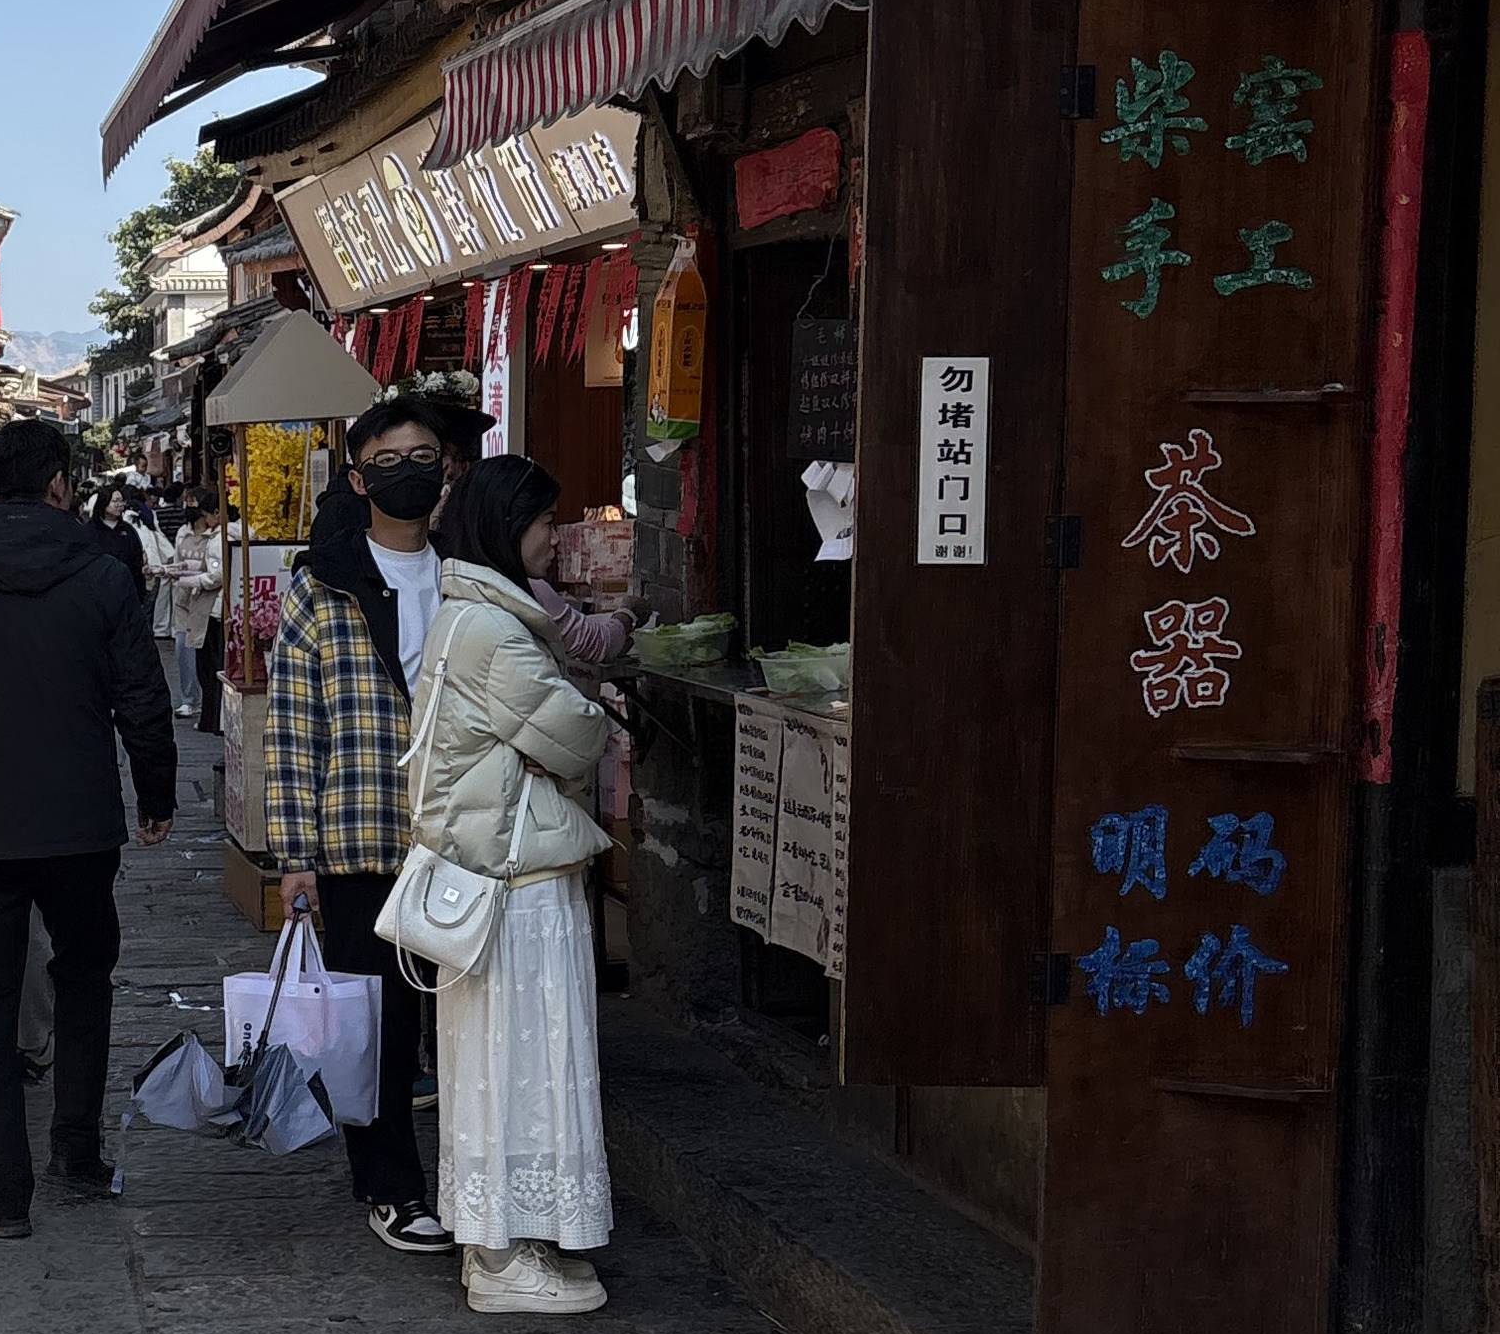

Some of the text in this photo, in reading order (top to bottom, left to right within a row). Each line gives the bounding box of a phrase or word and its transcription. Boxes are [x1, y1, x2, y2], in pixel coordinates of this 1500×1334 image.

[546, 131, 632, 214] 旗舰店
[1100, 197, 1316, 319] 手工
[936, 364, 976, 539] 勿堵站门口
[1121, 428, 1257, 717] 茶器
[1090, 804, 1287, 900] 明码
[1078, 923, 1289, 1028] 标价
